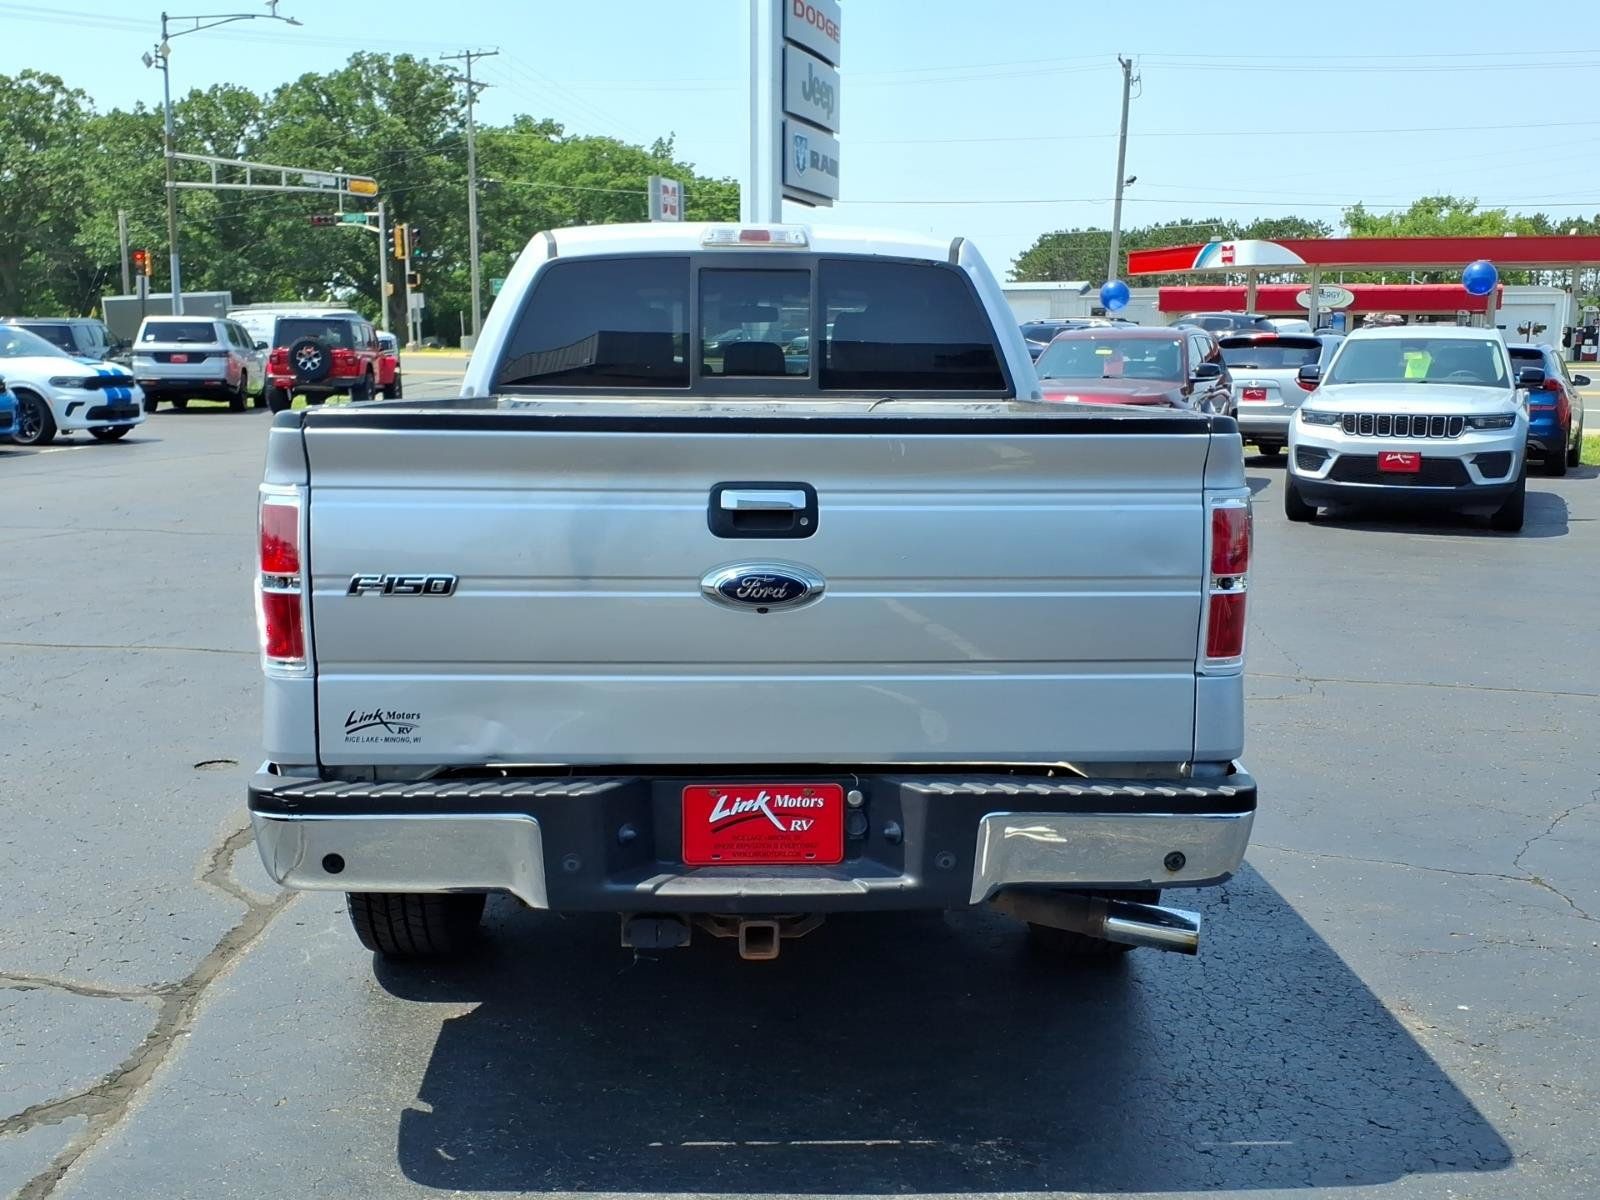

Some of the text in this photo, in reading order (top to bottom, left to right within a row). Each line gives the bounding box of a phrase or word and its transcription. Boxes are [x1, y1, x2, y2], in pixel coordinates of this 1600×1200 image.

[794, 0, 840, 44] DODGE
[802, 62, 833, 120] Jeep
[736, 576, 788, 599] Ford
[344, 708, 421, 734] Link Motors
[709, 791, 824, 831] Link Motors
[790, 819, 814, 831] RV
